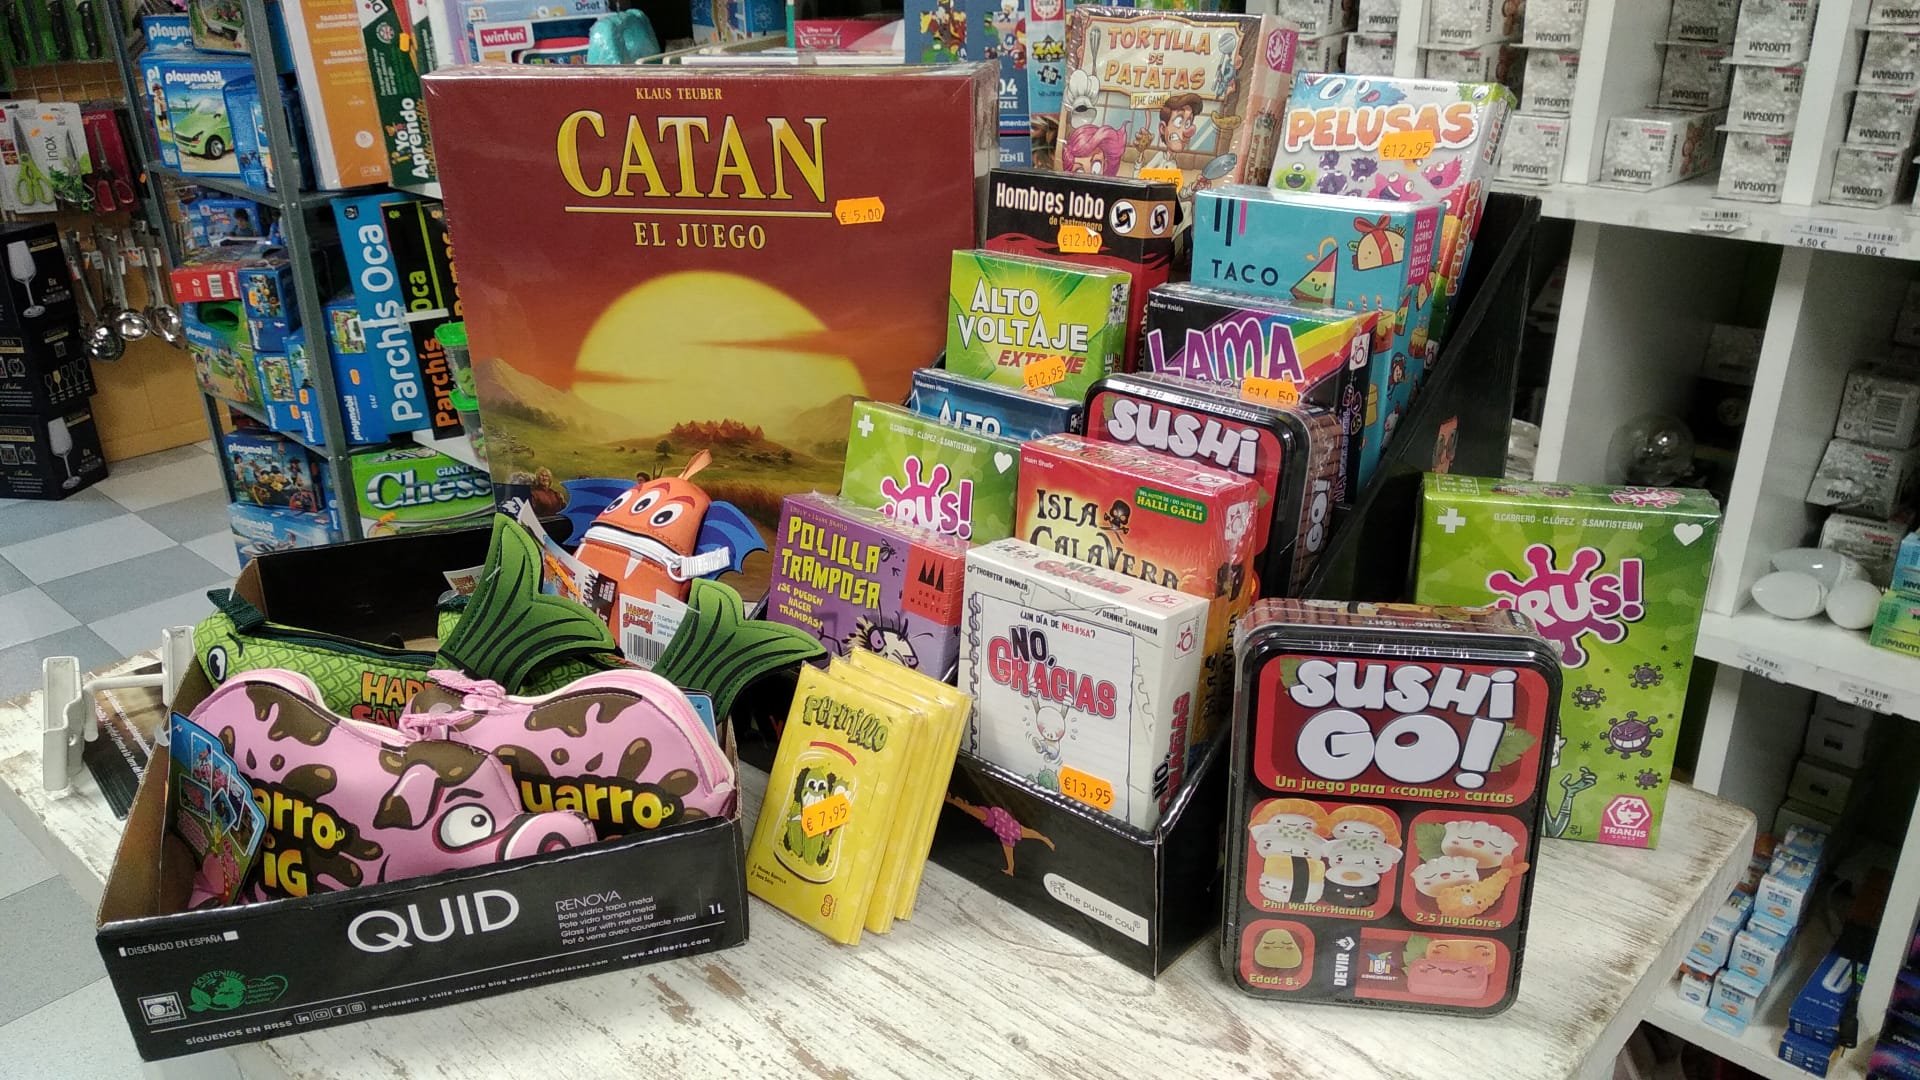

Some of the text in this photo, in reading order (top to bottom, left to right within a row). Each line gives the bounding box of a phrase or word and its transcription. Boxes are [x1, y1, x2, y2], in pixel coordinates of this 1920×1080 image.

[482, 31, 524, 44] winfun
[1107, 27, 1211, 55] TORTILLA
[1148, 52, 1164, 66] DE
[165, 70, 221, 84] playmobil
[1104, 60, 1206, 91] PATATAS
[635, 87, 723, 100] KLAUS TEUBER
[400, 97, 430, 178] Aprendo
[1287, 104, 1475, 147] PELUSAS
[44, 135, 59, 161] inox
[556, 109, 828, 203] CATAN
[1382, 140, 1432, 158] €12,95
[996, 183, 1105, 219] Hombres lobo
[840, 211, 848, 223] €
[1049, 217, 1058, 226] de
[633, 222, 766, 250] EL JUEGO
[359, 224, 394, 292] Oca
[1211, 258, 1279, 286] TACO
[971, 277, 1040, 317] ALTO
[957, 311, 1089, 353] VOLTAJE
[1147, 317, 1305, 384] LAMA
[1028, 366, 1064, 388] €12,95
[344, 395, 363, 441] playmobil
[229, 443, 273, 455] playmobil
[436, 465, 471, 478] GIANT
[366, 471, 493, 511] Chess
[1036, 488, 1099, 529] ISLA
[1137, 495, 1203, 520] HALLI GALLI
[1542, 515, 1575, 527] C.LÓPEZ
[1581, 518, 1644, 531] S.SANTISTEBAN
[787, 516, 881, 574] POLILLA
[781, 547, 881, 610] TRAMPOSA
[788, 597, 812, 613] HACER
[793, 586, 824, 607] PUEDEN
[779, 604, 824, 629] TRAMPAS!
[1050, 618, 1060, 628] DE
[1102, 609, 1123, 624] DENNIS
[1009, 624, 1057, 667] NO,
[987, 636, 1117, 719] GRACIAS
[1297, 708, 1505, 789] GO!
[1064, 775, 1112, 804] €13,95
[1275, 775, 1297, 789] Un
[1300, 777, 1345, 794] juego
[1350, 782, 1385, 798] para
[1465, 791, 1514, 804] cartas
[806, 803, 848, 832] € 7,95
[1603, 826, 1647, 838] TRANJIS
[264, 850, 308, 898] IG
[555, 890, 622, 913] RENOVA
[557, 896, 654, 921] Bote vidrio tapa metal
[1065, 890, 1113, 923] the purple
[1263, 899, 1375, 919] Phil Walker-Harding
[347, 889, 520, 953] QUID
[559, 904, 657, 930] Pote vidro tampa metal
[560, 913, 654, 938] Glass jar with metal lid
[562, 937, 577, 946] Pot
[608, 928, 630, 938] avec
[672, 913, 697, 924] metal
[1416, 911, 1502, 929] 2-5 jugadores
[127, 933, 224, 957] DISEÑADO EN ESPAÑA
[193, 969, 247, 986] SOSTENIBLE
[1250, 972, 1302, 988] Edad: 8+
[1333, 953, 1350, 987] DEVIR
[185, 1028, 243, 1046] SÍGUENOS
[245, 1025, 261, 1034] EN
[264, 1019, 293, 1031] RRSS
